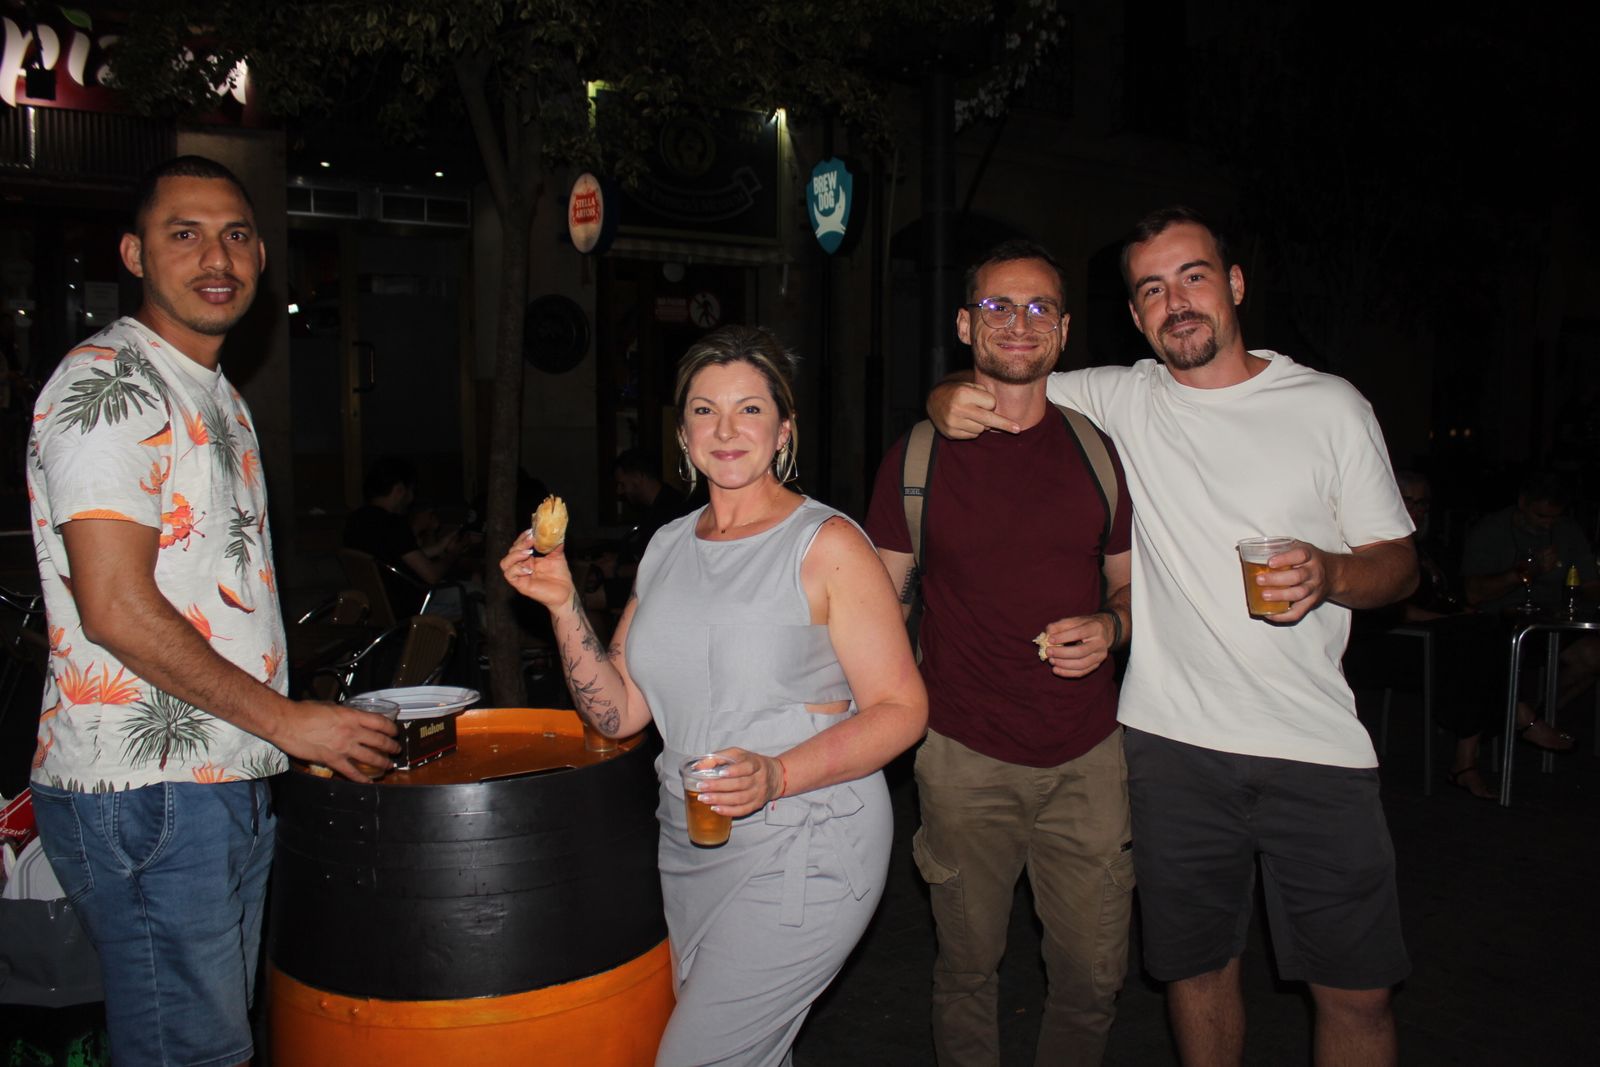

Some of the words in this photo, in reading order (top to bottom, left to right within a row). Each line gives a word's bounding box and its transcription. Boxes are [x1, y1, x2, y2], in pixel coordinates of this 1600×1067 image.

[813, 170, 837, 195] BREW
[576, 198, 596, 209] STELLA
[818, 190, 835, 211] DOG
[576, 207, 596, 218] ARTOIS
[420, 722, 445, 738] Mahou
